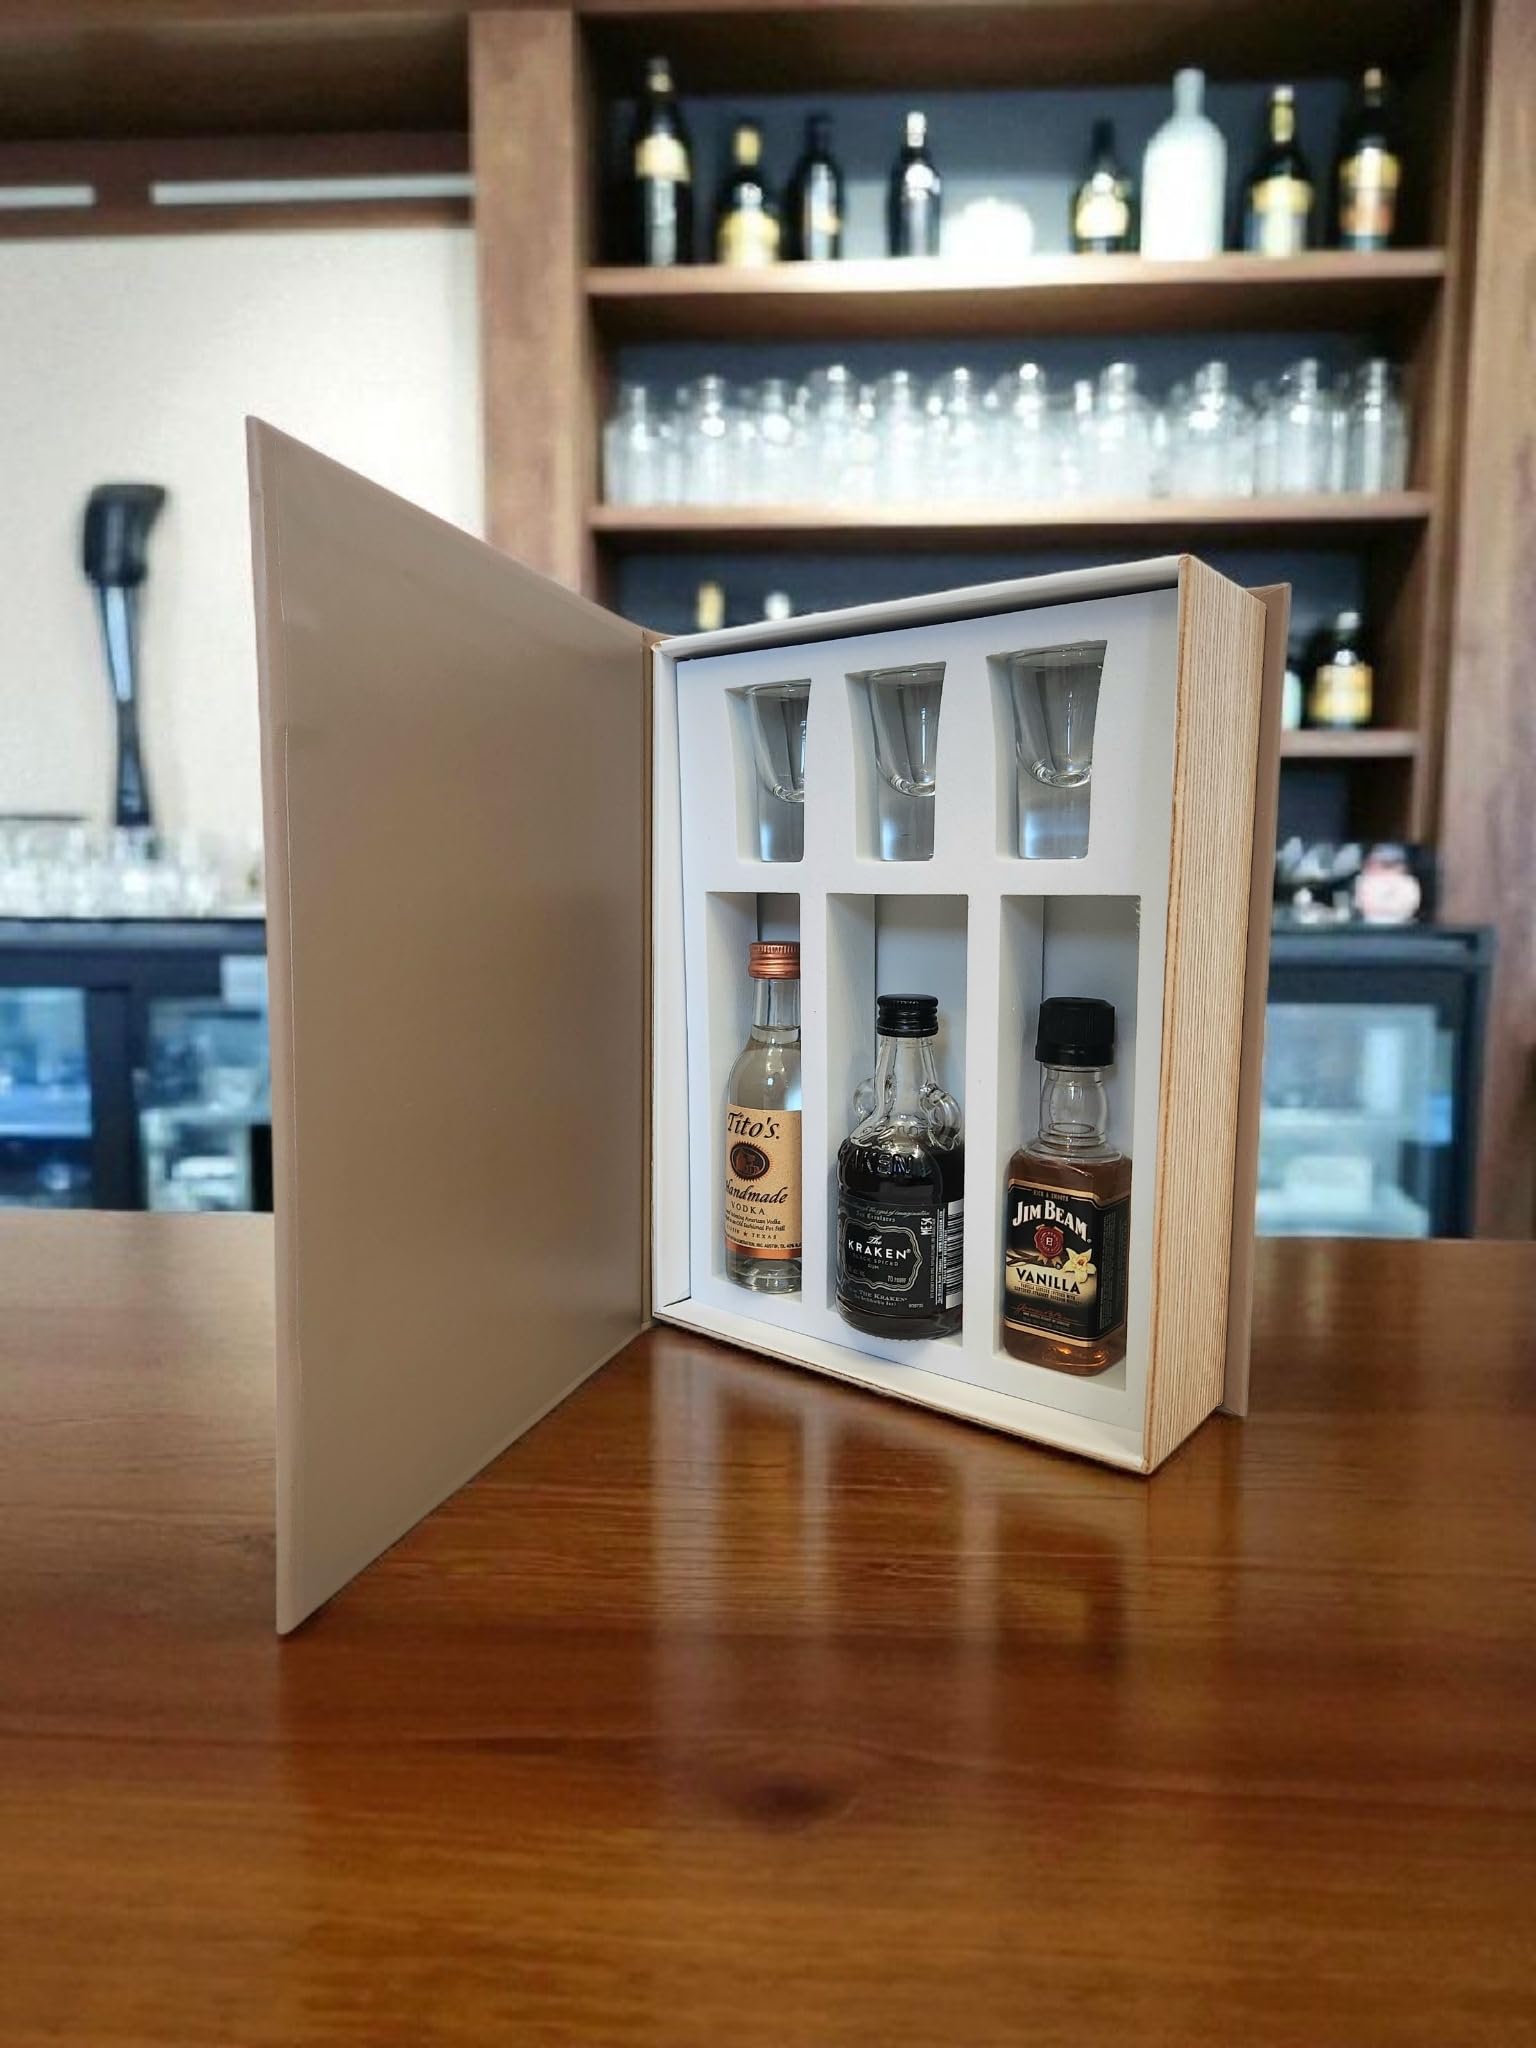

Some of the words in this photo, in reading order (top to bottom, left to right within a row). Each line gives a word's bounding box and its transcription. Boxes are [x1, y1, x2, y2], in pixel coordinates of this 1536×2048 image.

[731, 1201, 766, 1216] VODKA
[1012, 1201, 1042, 1227] JIM
[751, 1232, 777, 1240] TEXAS
[1016, 1267, 1081, 1295] VANILLA
